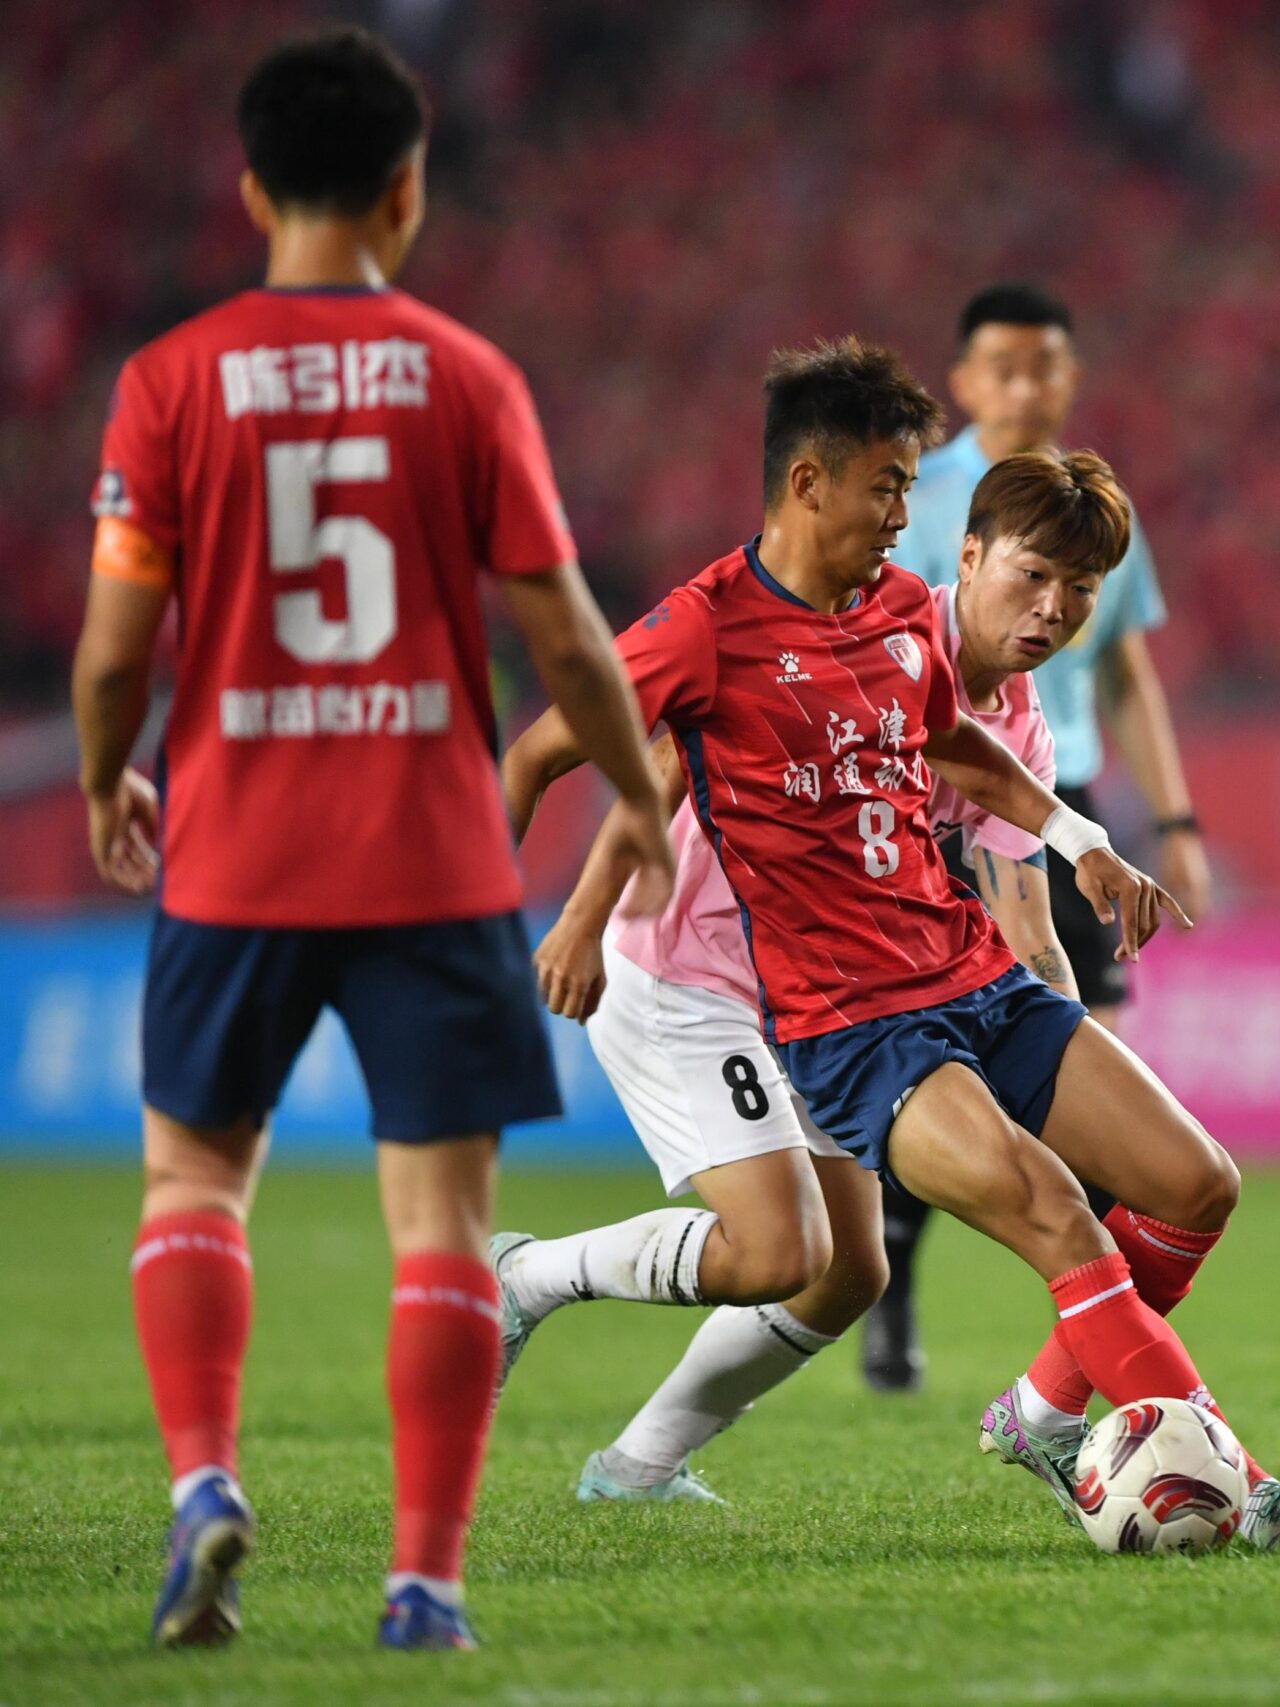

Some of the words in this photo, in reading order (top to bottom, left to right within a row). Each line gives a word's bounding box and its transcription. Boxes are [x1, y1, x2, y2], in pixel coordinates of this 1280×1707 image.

[220, 338, 430, 419] 陈引杰
[265, 437, 397, 664] 5
[776, 673, 813, 684] KELME
[826, 697, 907, 754] 江津
[858, 800, 900, 879] 8
[722, 1054, 770, 1121] 8
